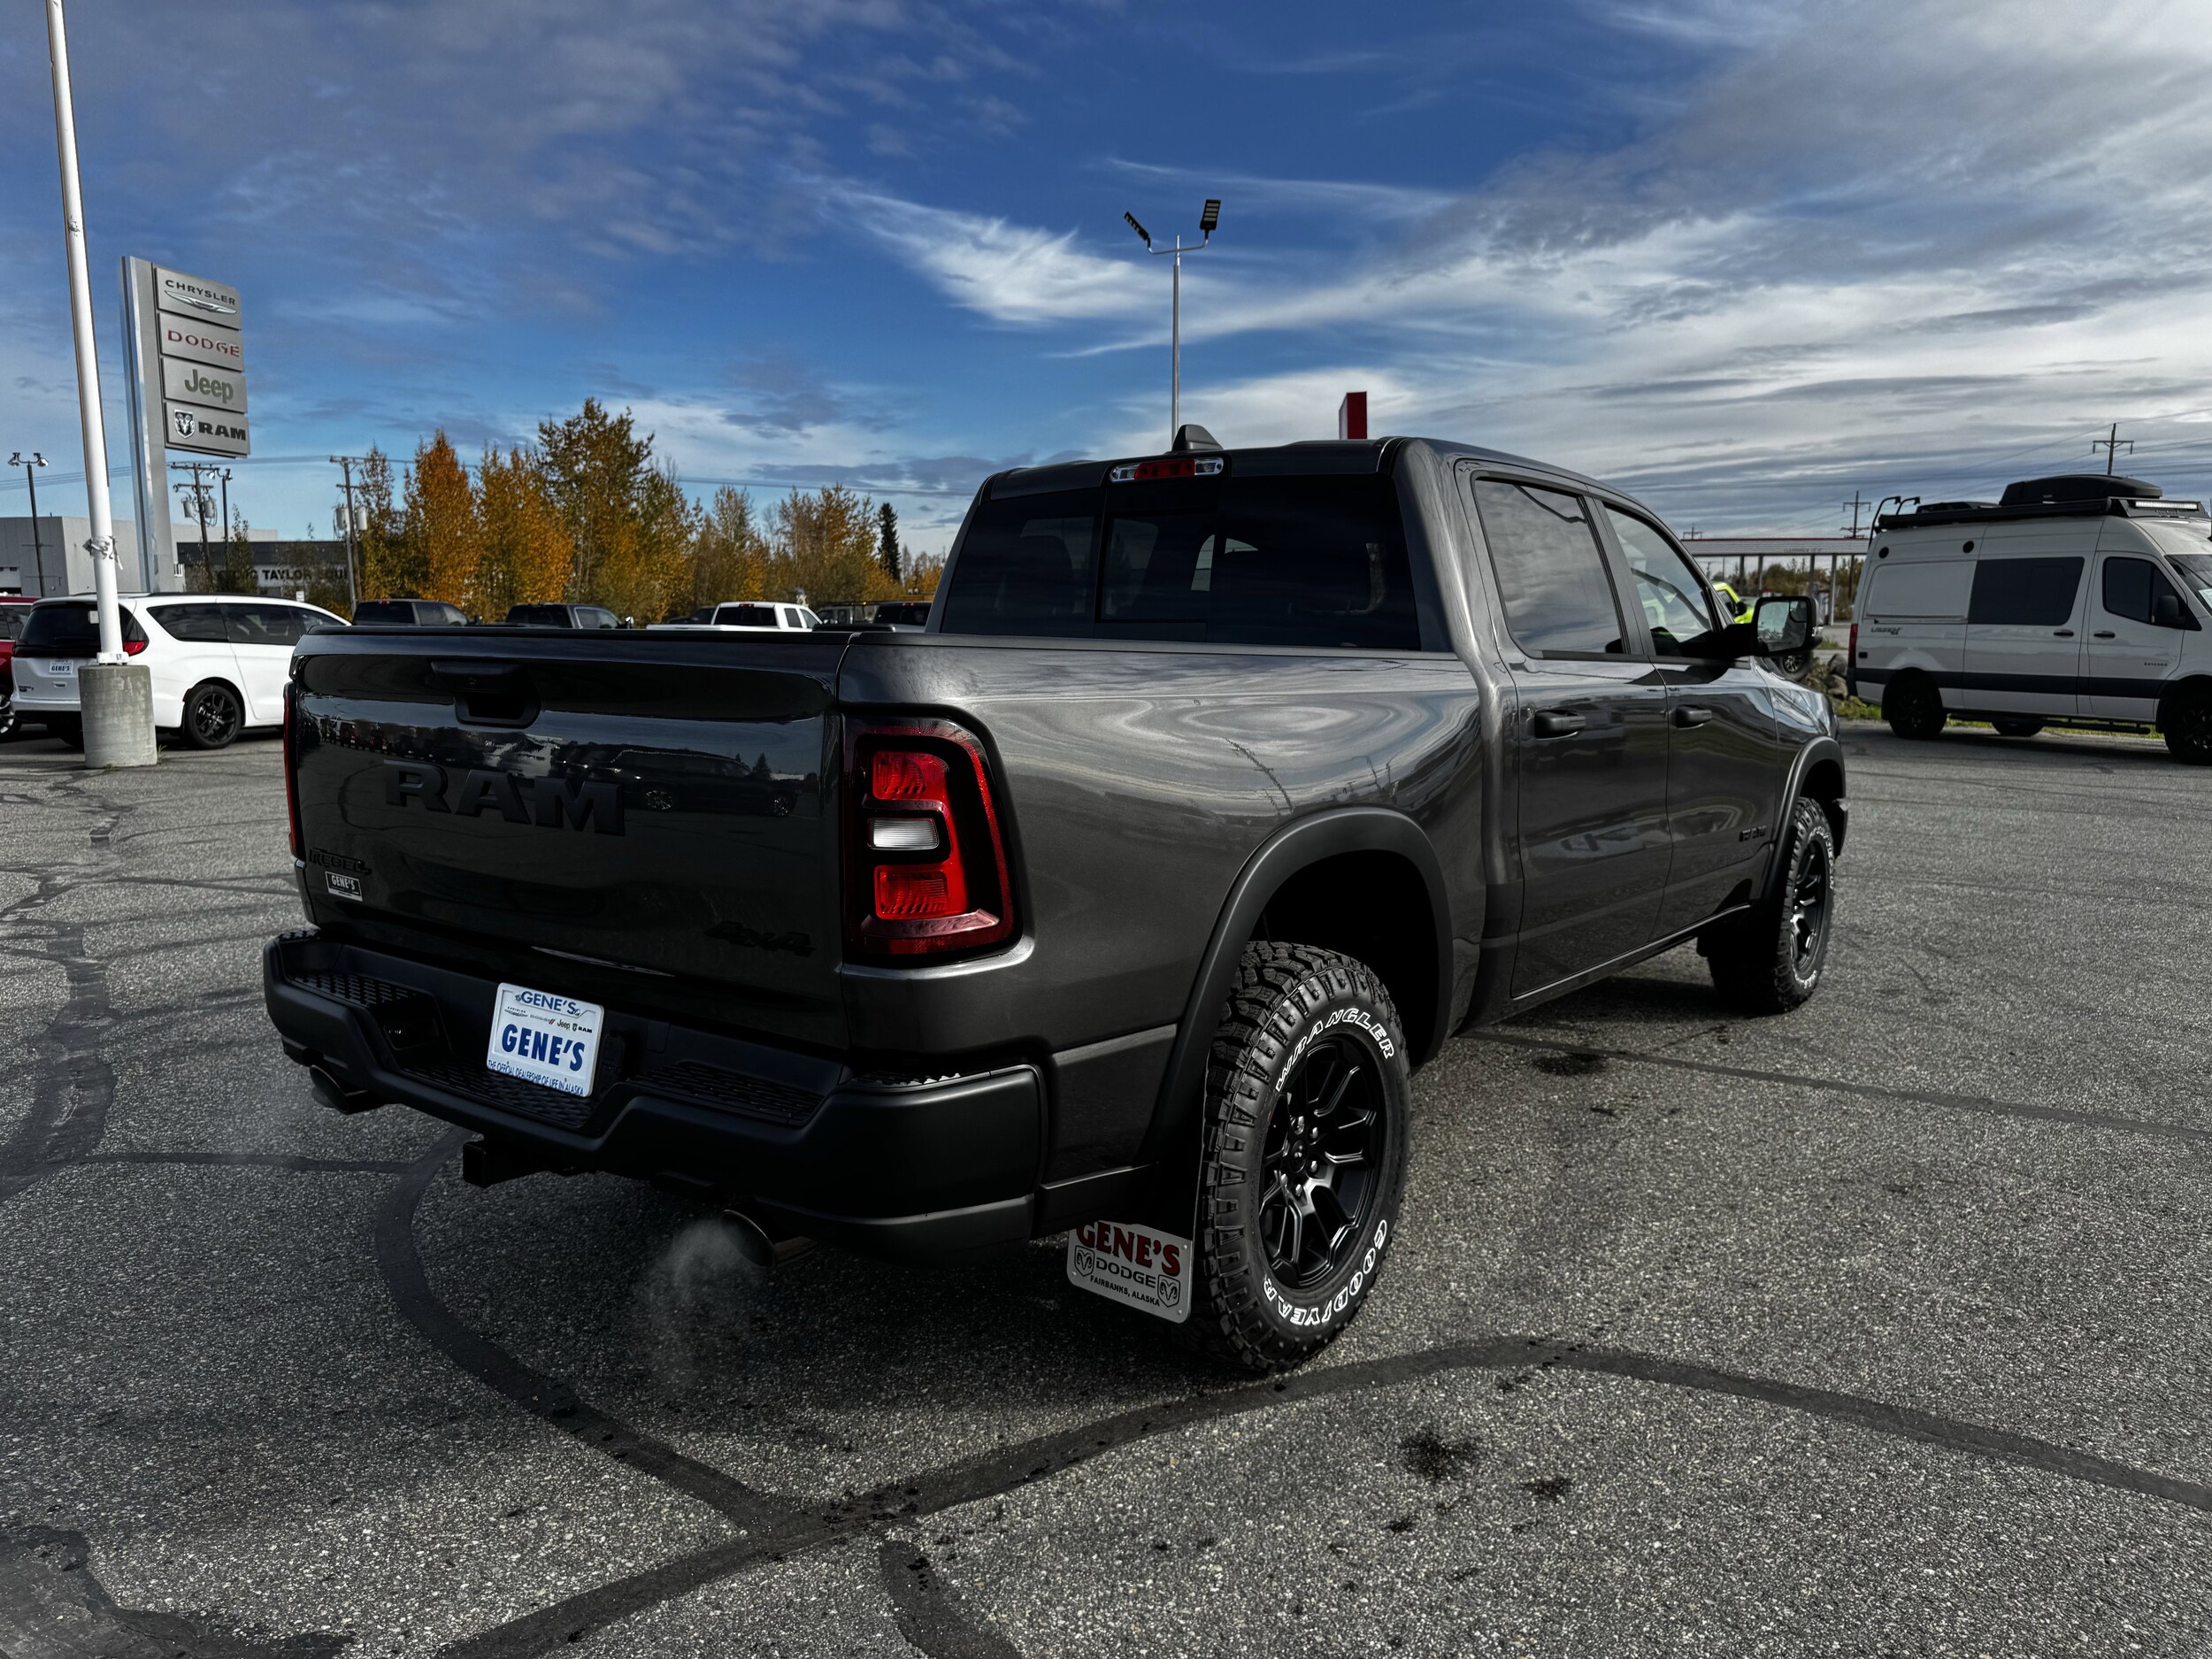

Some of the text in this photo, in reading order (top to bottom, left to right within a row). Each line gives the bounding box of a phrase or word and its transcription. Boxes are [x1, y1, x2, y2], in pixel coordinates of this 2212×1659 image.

[165, 280, 236, 305] CHRYSLER
[167, 330, 240, 357] DODGE
[184, 368, 234, 403] Jeep
[198, 421, 247, 441] RAM
[262, 569, 311, 580] TAYLOR
[384, 759, 626, 837] RAM
[309, 848, 373, 876] REBEL
[331, 874, 356, 890] GENE'S
[520, 991, 577, 1015] GENE'S
[557, 1019, 570, 1031] Jeep
[502, 1024, 585, 1071] GENE'S
[1275, 1008, 1394, 1092] WRANGLER
[496, 1062, 514, 1076] OFFICIAL
[515, 1068, 541, 1083] DEALERSHIP
[541, 1076, 549, 1086] OF
[549, 1078, 558, 1088] LIFE
[558, 1080, 565, 1090] IN
[565, 1083, 584, 1095] ALASKA
[1076, 1220, 1181, 1277] GENE'S
[1096, 1256, 1156, 1288] DODGE
[1263, 1219, 1387, 1326] GOODYEAR
[1090, 1275, 1160, 1307] FAIRBANKS, ALASKA
